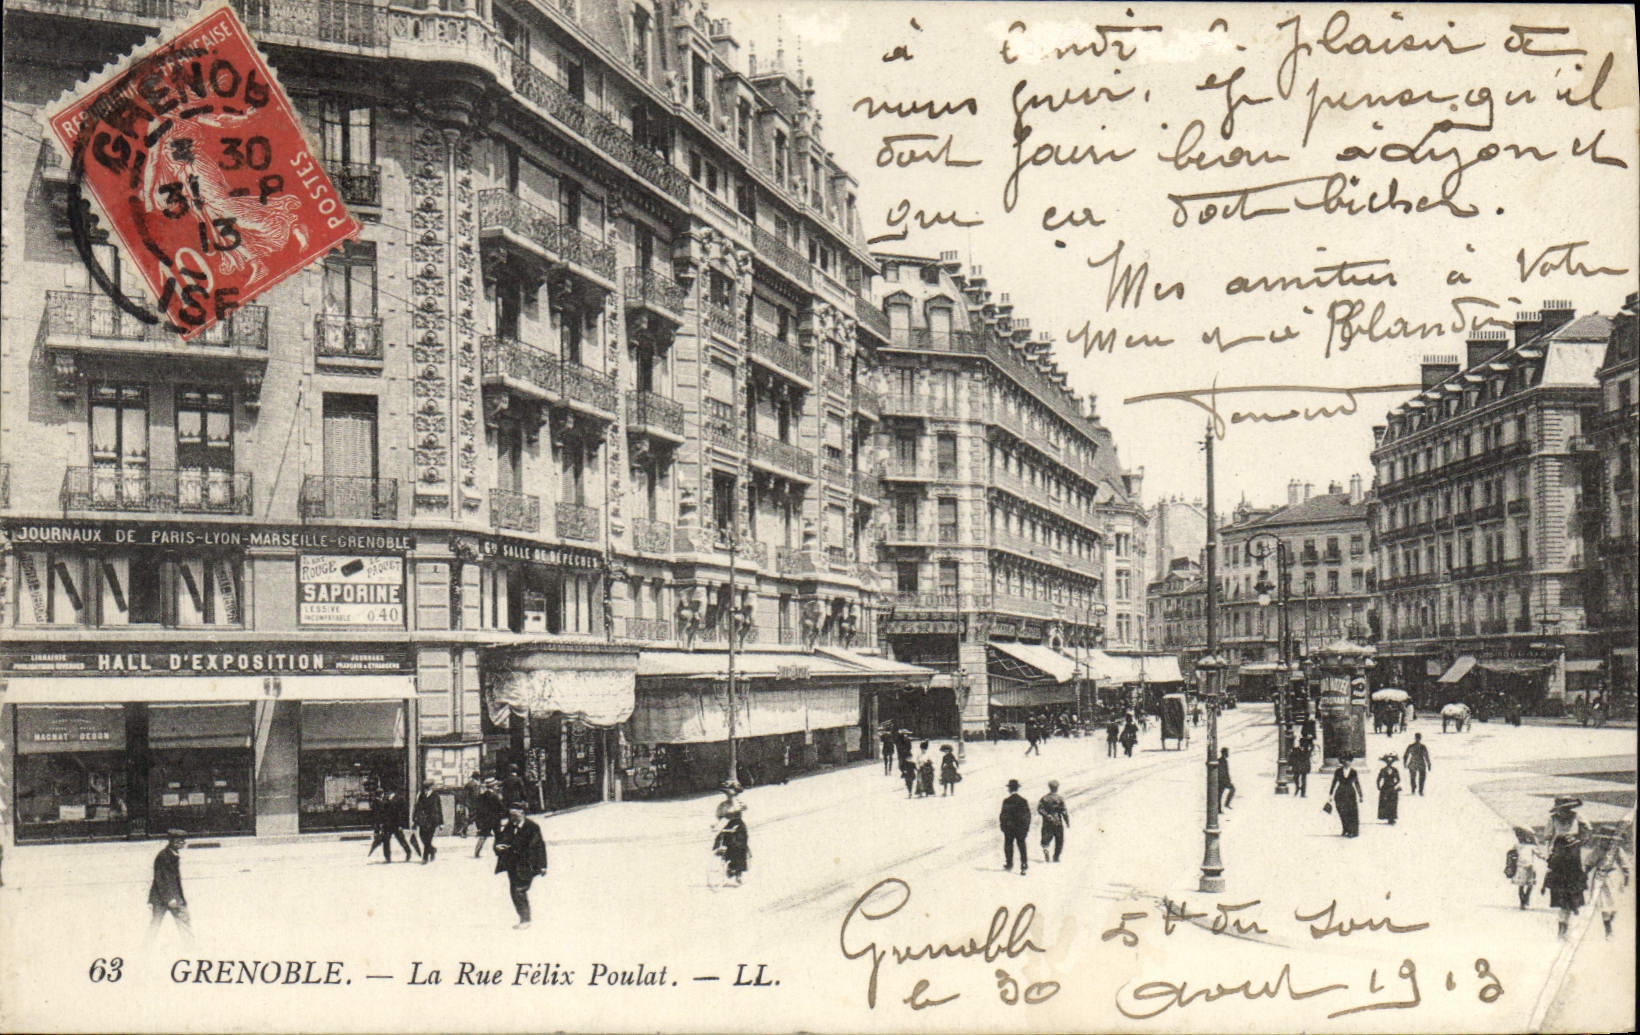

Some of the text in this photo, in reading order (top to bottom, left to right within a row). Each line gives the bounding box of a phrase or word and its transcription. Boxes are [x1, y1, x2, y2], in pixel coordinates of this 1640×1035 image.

[290, 150, 346, 230] POSTES
[17, 526, 101, 542] JOURNAUX
[115, 530, 136, 543] DE
[301, 560, 338, 581] ROUGE
[303, 584, 401, 603] SAPORINE
[97, 653, 324, 670] HALL D'EXPOSITION
